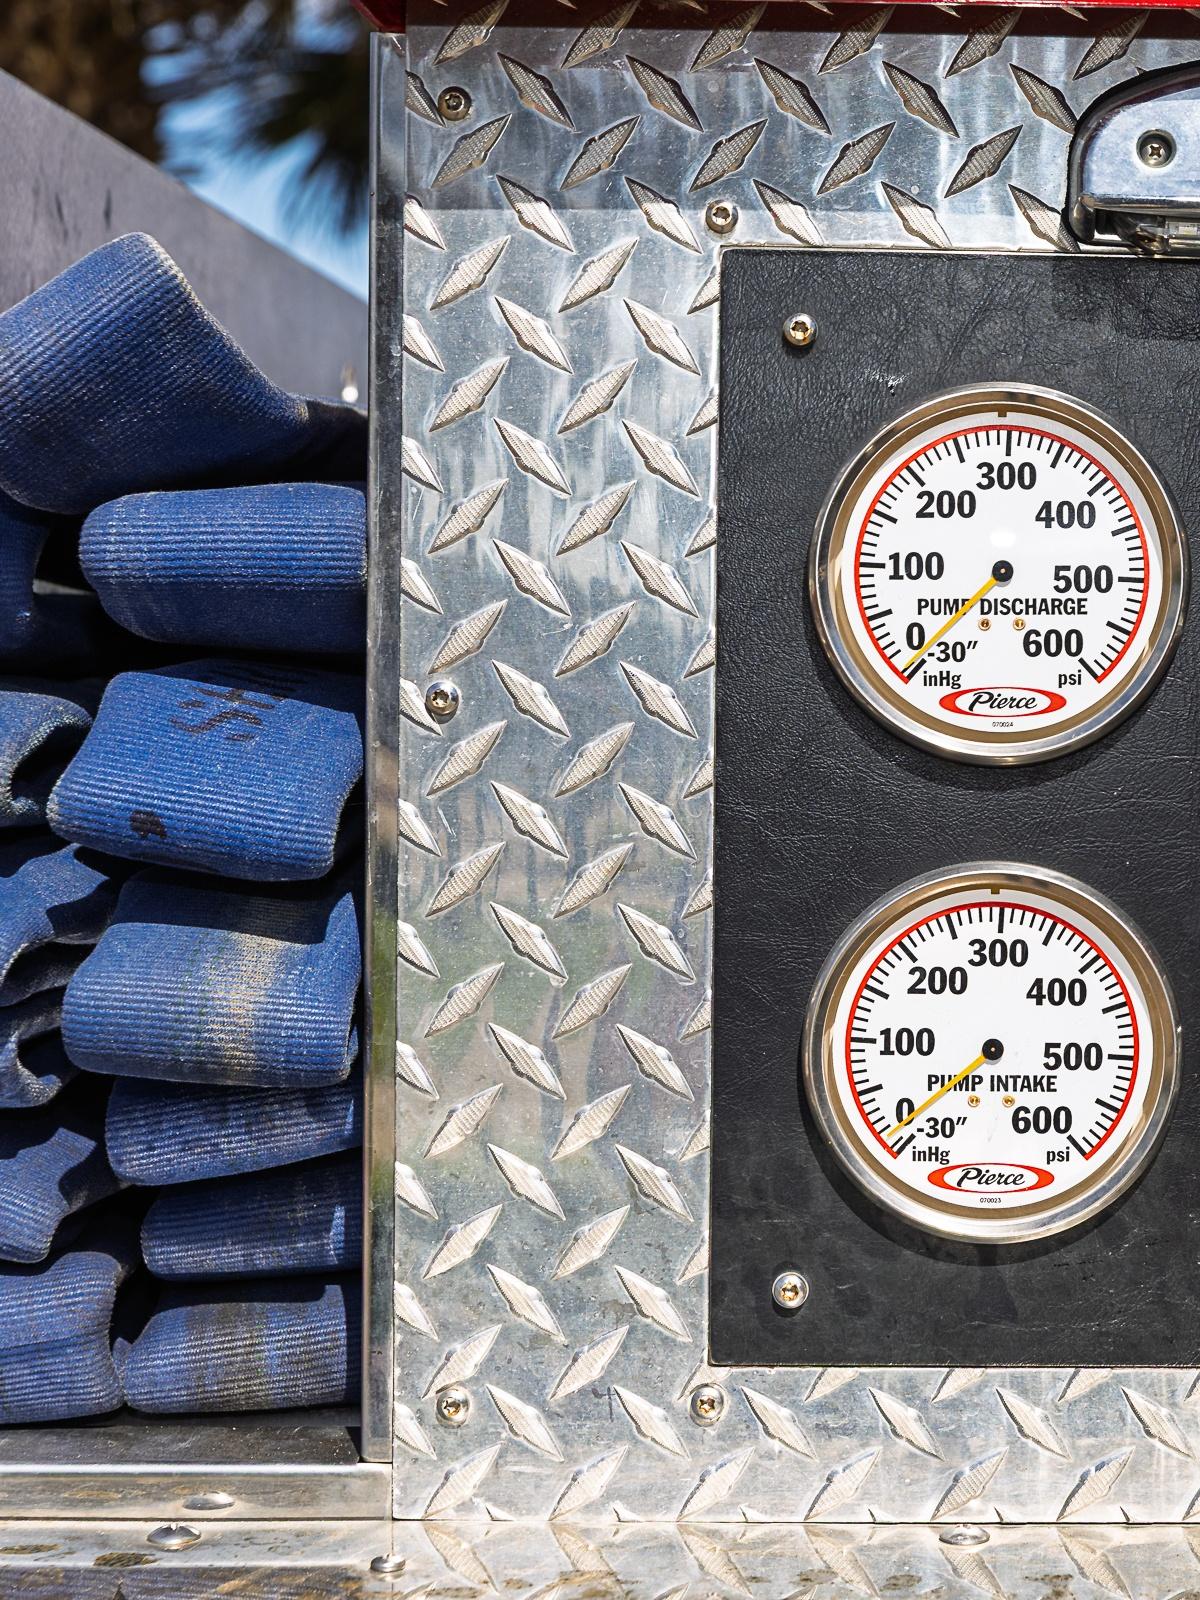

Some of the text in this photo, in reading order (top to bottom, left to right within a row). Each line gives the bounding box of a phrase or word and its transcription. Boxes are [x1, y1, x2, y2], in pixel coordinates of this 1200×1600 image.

[976, 462, 1037, 490] 300
[915, 490, 976, 518] 200
[1035, 500, 1096, 529] 400
[888, 552, 944, 580] 100
[1053, 565, 1113, 593] 500
[980, 598, 1088, 615] DISCHARGE
[906, 622, 926, 650] 0
[1022, 629, 1084, 657] 600
[923, 671, 962, 689] inHg
[1058, 669, 1082, 688] psi
[968, 691, 1039, 712] Pierce
[967, 938, 1029, 968] 300
[907, 966, 968, 995] 200
[1026, 977, 1087, 1006] 400
[879, 1028, 935, 1056] 100
[1043, 1042, 1103, 1071] 500
[927, 1074, 1057, 1092] PUMP INTAKE
[895, 1097, 915, 1127] 0
[1011, 1105, 1073, 1134] 600
[912, 1146, 950, 1165] inHg
[1046, 1146, 1070, 1165] psi
[956, 1167, 1026, 1187] Pierce
